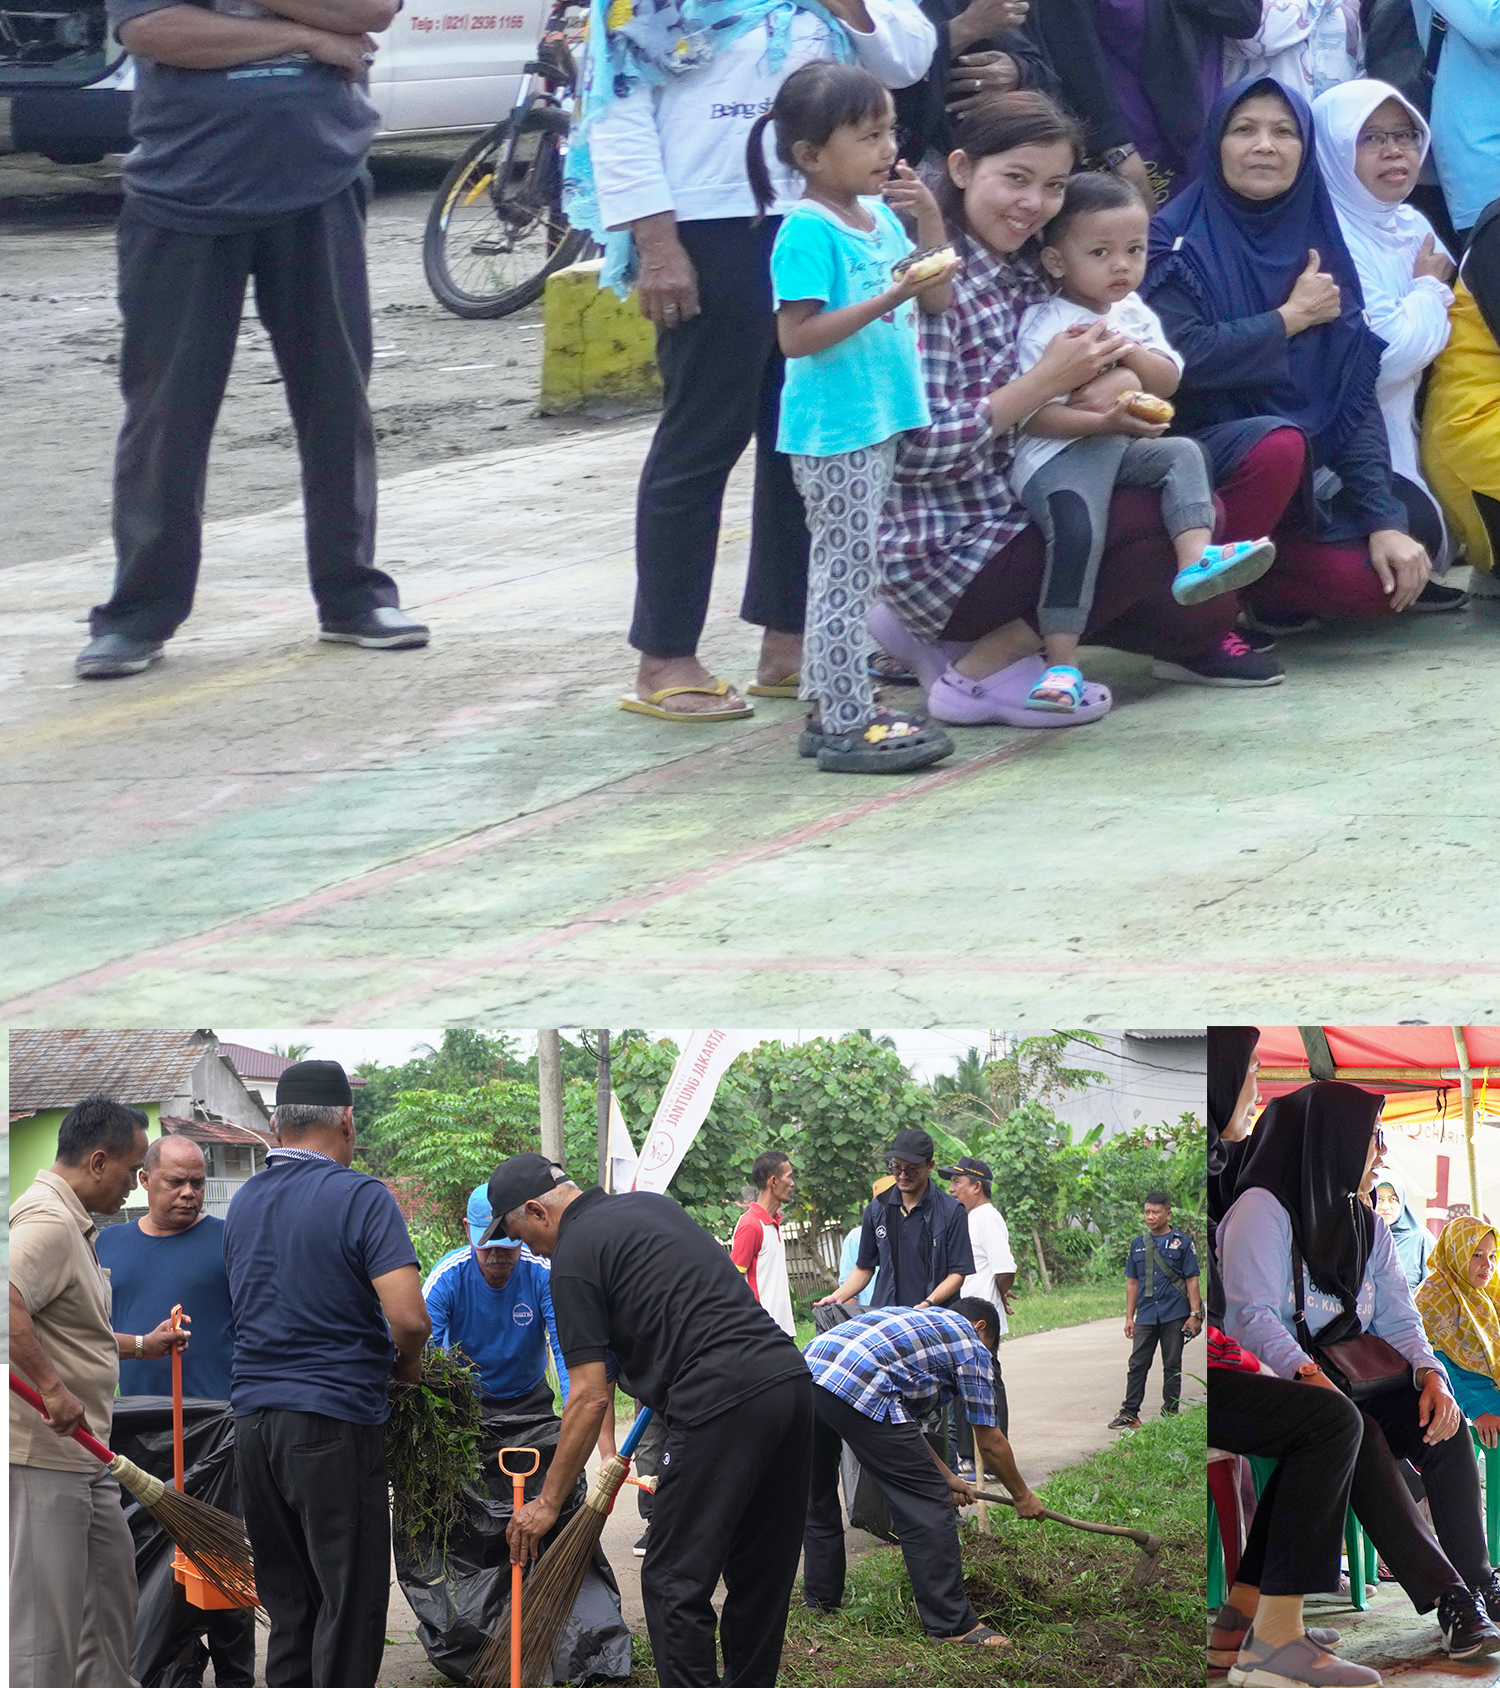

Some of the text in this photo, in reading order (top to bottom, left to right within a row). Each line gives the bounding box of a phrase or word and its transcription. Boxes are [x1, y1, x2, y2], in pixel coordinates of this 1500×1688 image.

[411, 16, 433, 33] Telp
[441, 12, 469, 32] (021)
[709, 100, 756, 120] Being
[666, 1029, 727, 1127] JANTUNG JAKARTA
[1288, 1291, 1319, 1309] KC.
